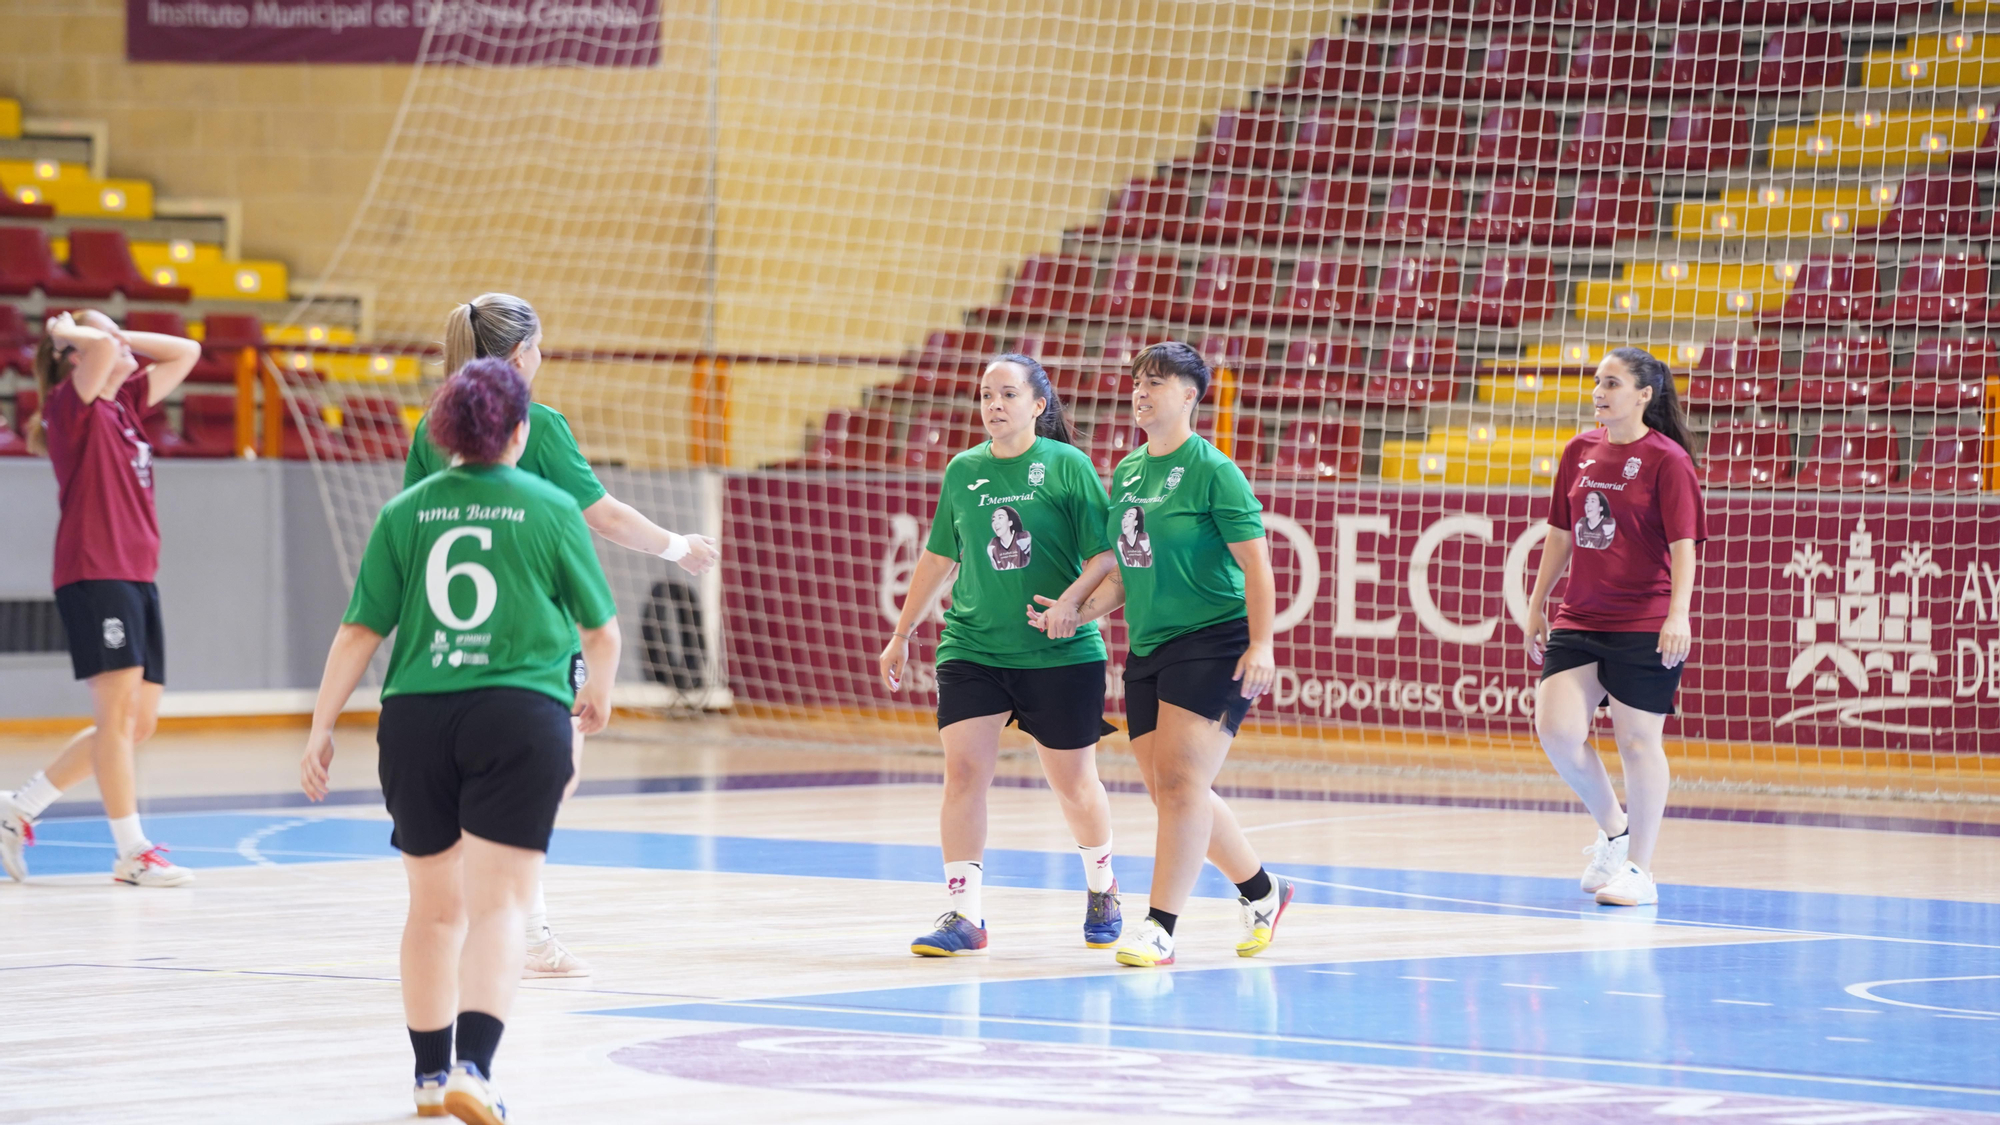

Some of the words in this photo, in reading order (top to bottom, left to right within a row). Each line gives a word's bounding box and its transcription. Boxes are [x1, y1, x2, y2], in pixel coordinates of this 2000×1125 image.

[148, 1, 248, 28] Instituto
[252, 1, 373, 35] Municipal
[374, 1, 410, 28] de
[1584, 479, 1628, 492] Memorial
[986, 490, 1037, 506] Memorial
[1125, 494, 1168, 504] Memorial
[466, 504, 526, 523] Baena
[425, 525, 498, 631] 6
[1274, 667, 1443, 719] Deportes
